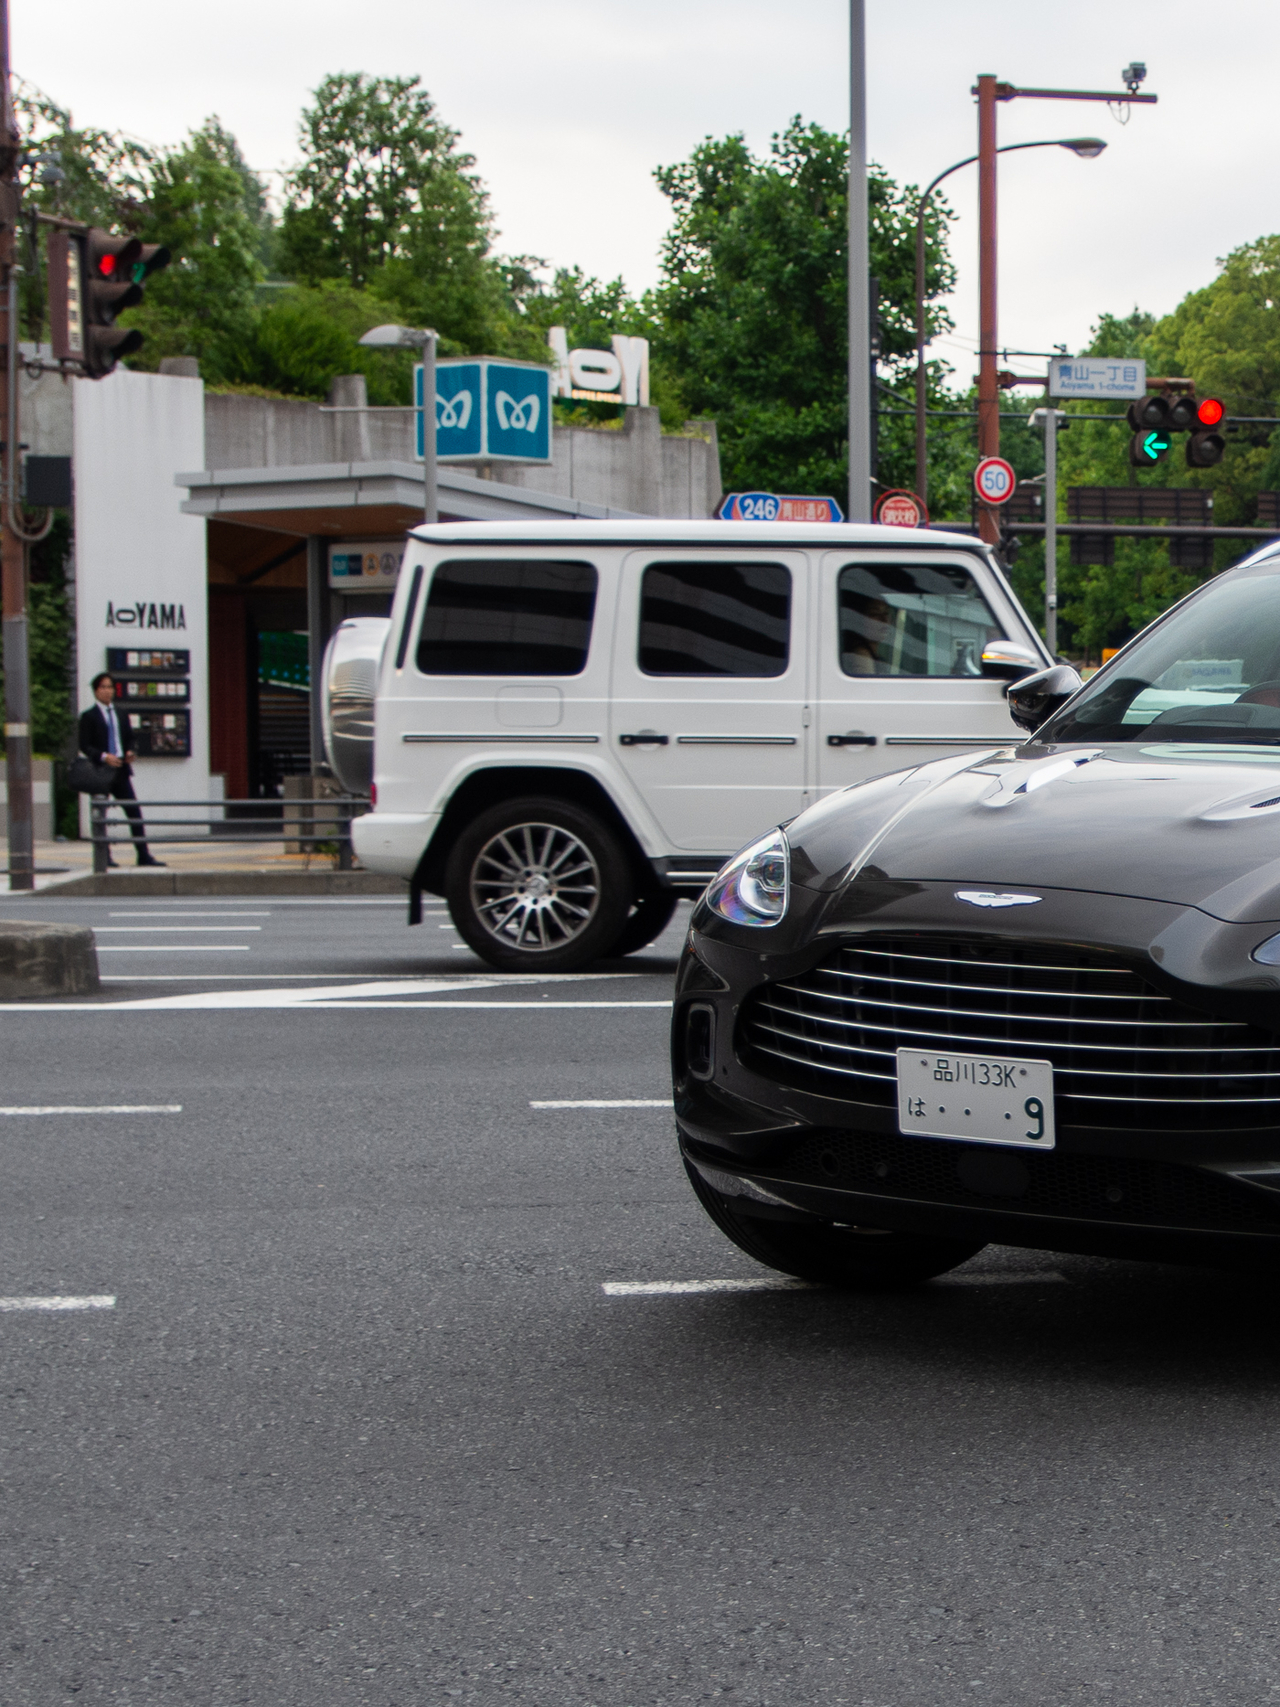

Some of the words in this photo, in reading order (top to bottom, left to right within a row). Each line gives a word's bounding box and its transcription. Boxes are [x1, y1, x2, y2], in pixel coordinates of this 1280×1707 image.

[1059, 364, 1137, 382] 青山一丁目
[984, 470, 1006, 491] 50
[744, 498, 776, 520] 246
[105, 600, 187, 630] AOYAMA
